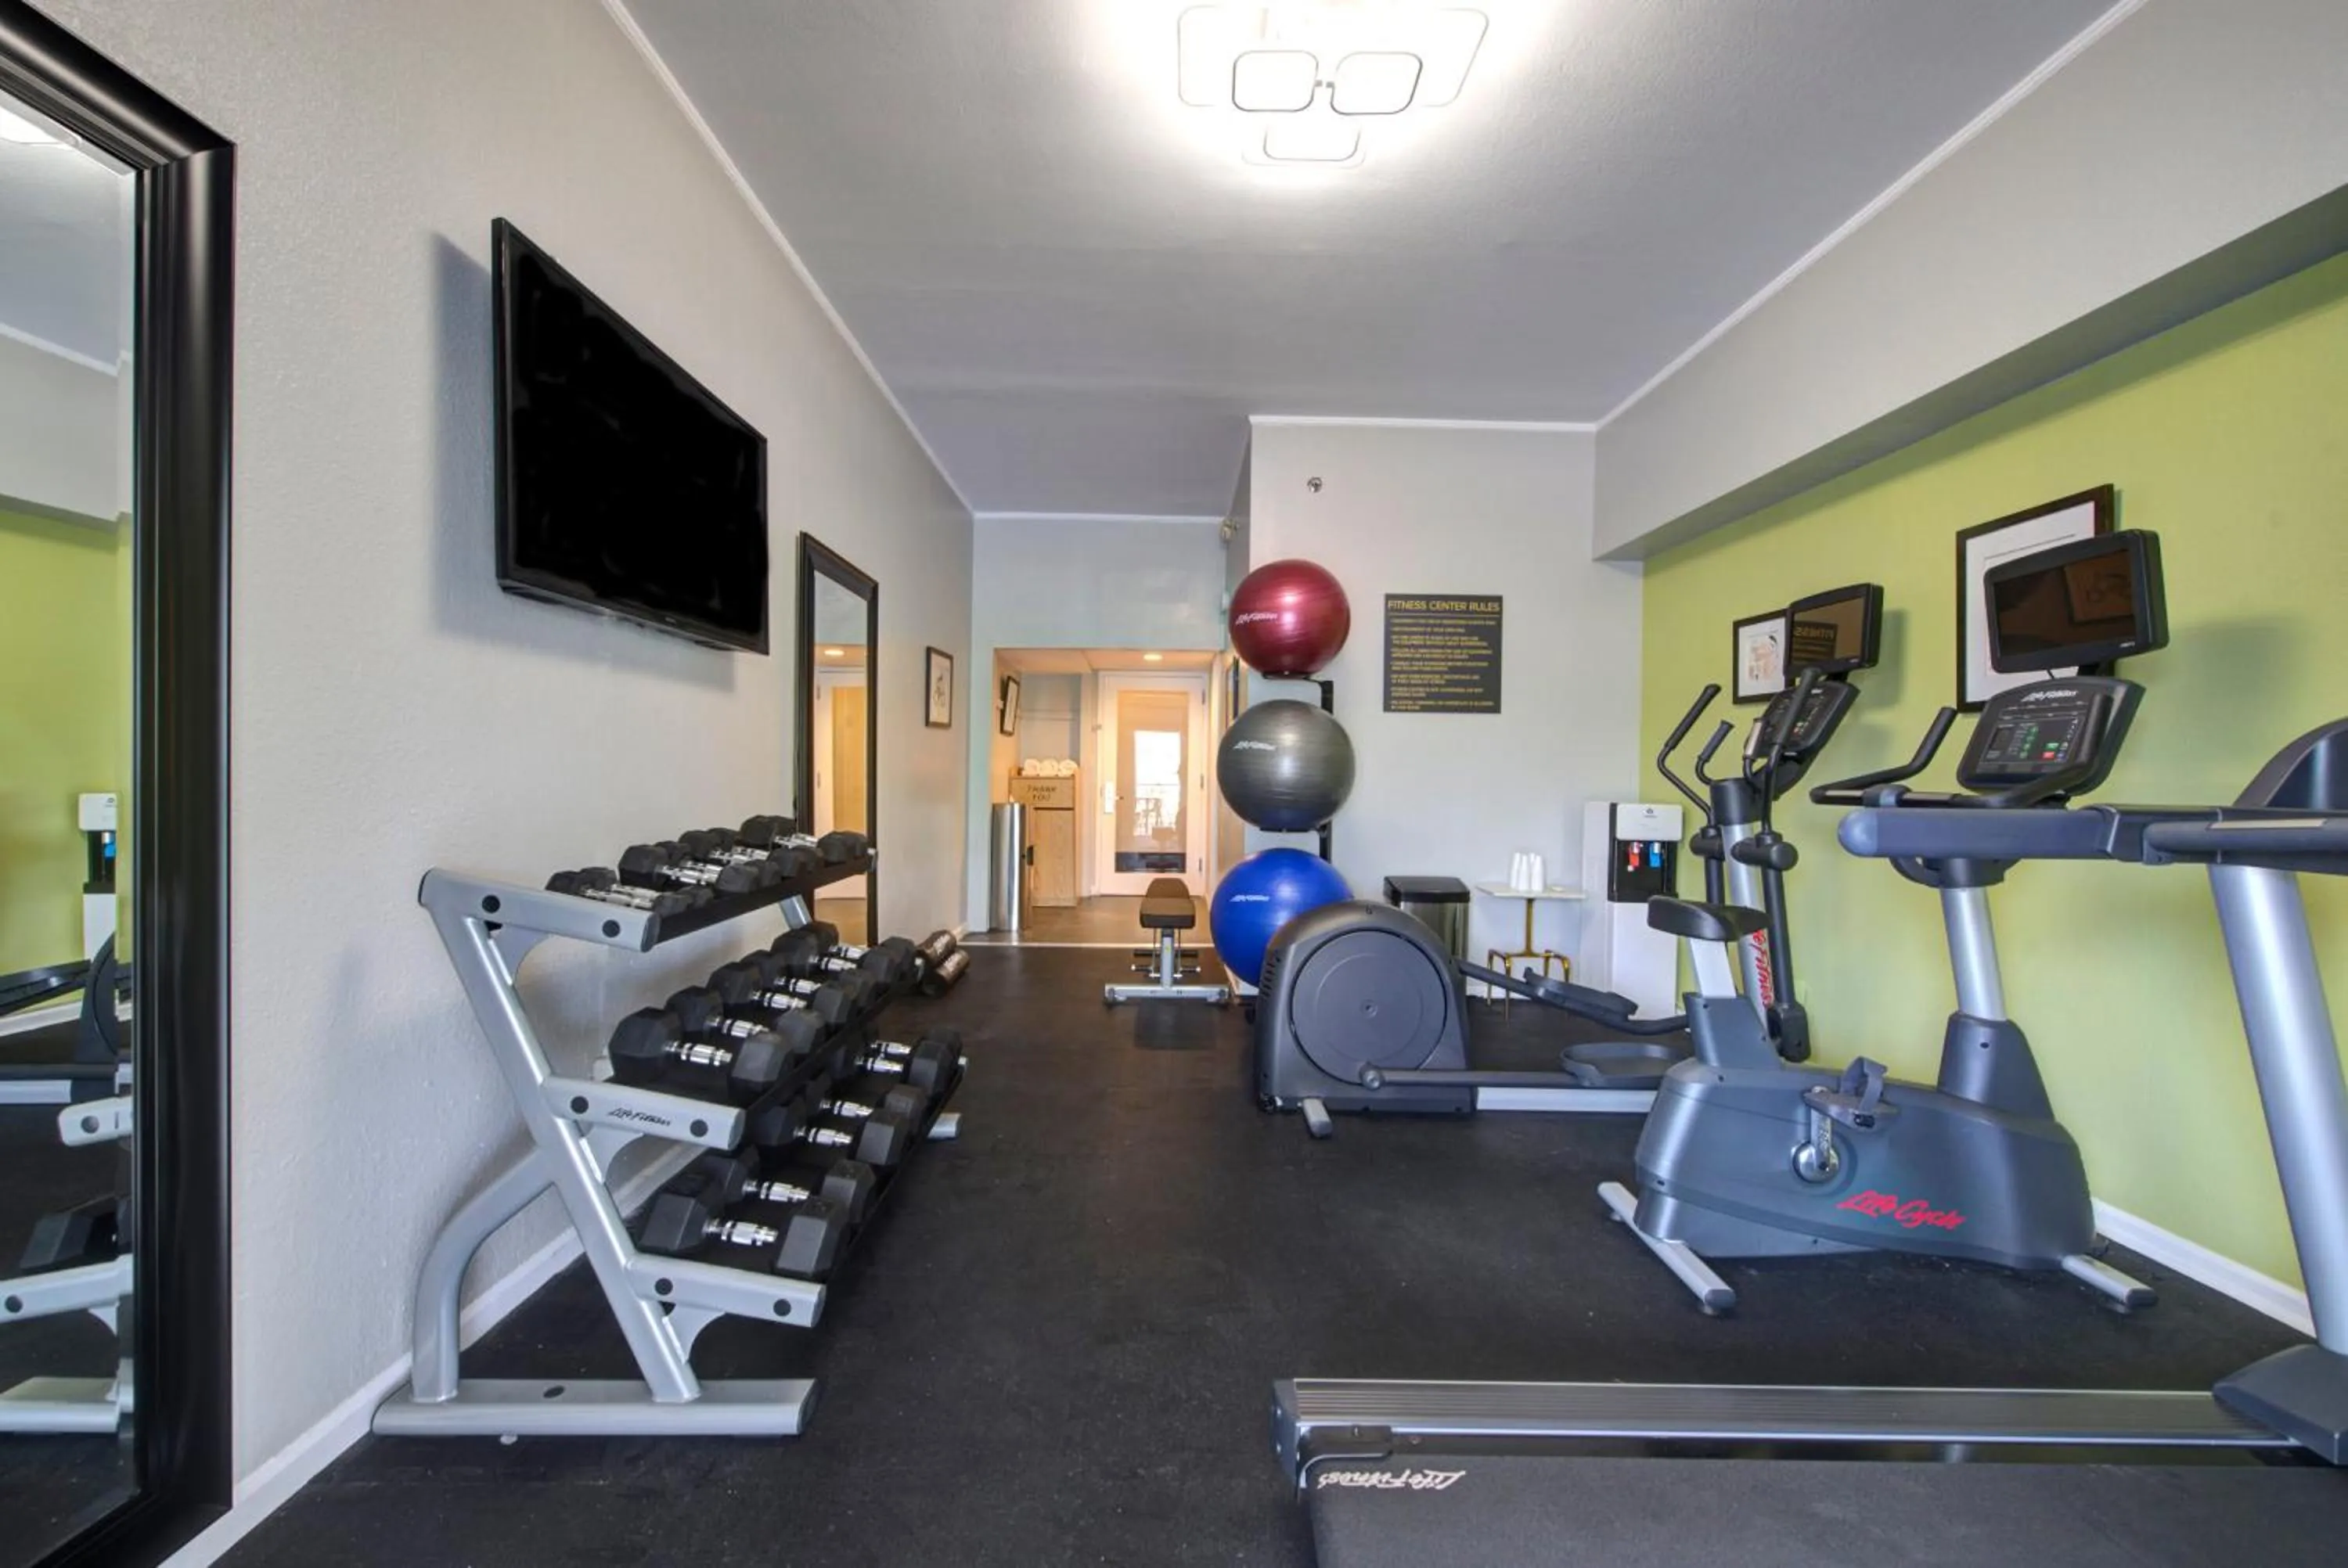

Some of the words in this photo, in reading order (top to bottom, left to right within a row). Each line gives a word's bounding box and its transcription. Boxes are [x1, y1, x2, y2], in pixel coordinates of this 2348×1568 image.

[1388, 600, 1427, 610] FITNESS
[1429, 601, 1467, 611] CENTER
[1469, 602, 1500, 612] RULES
